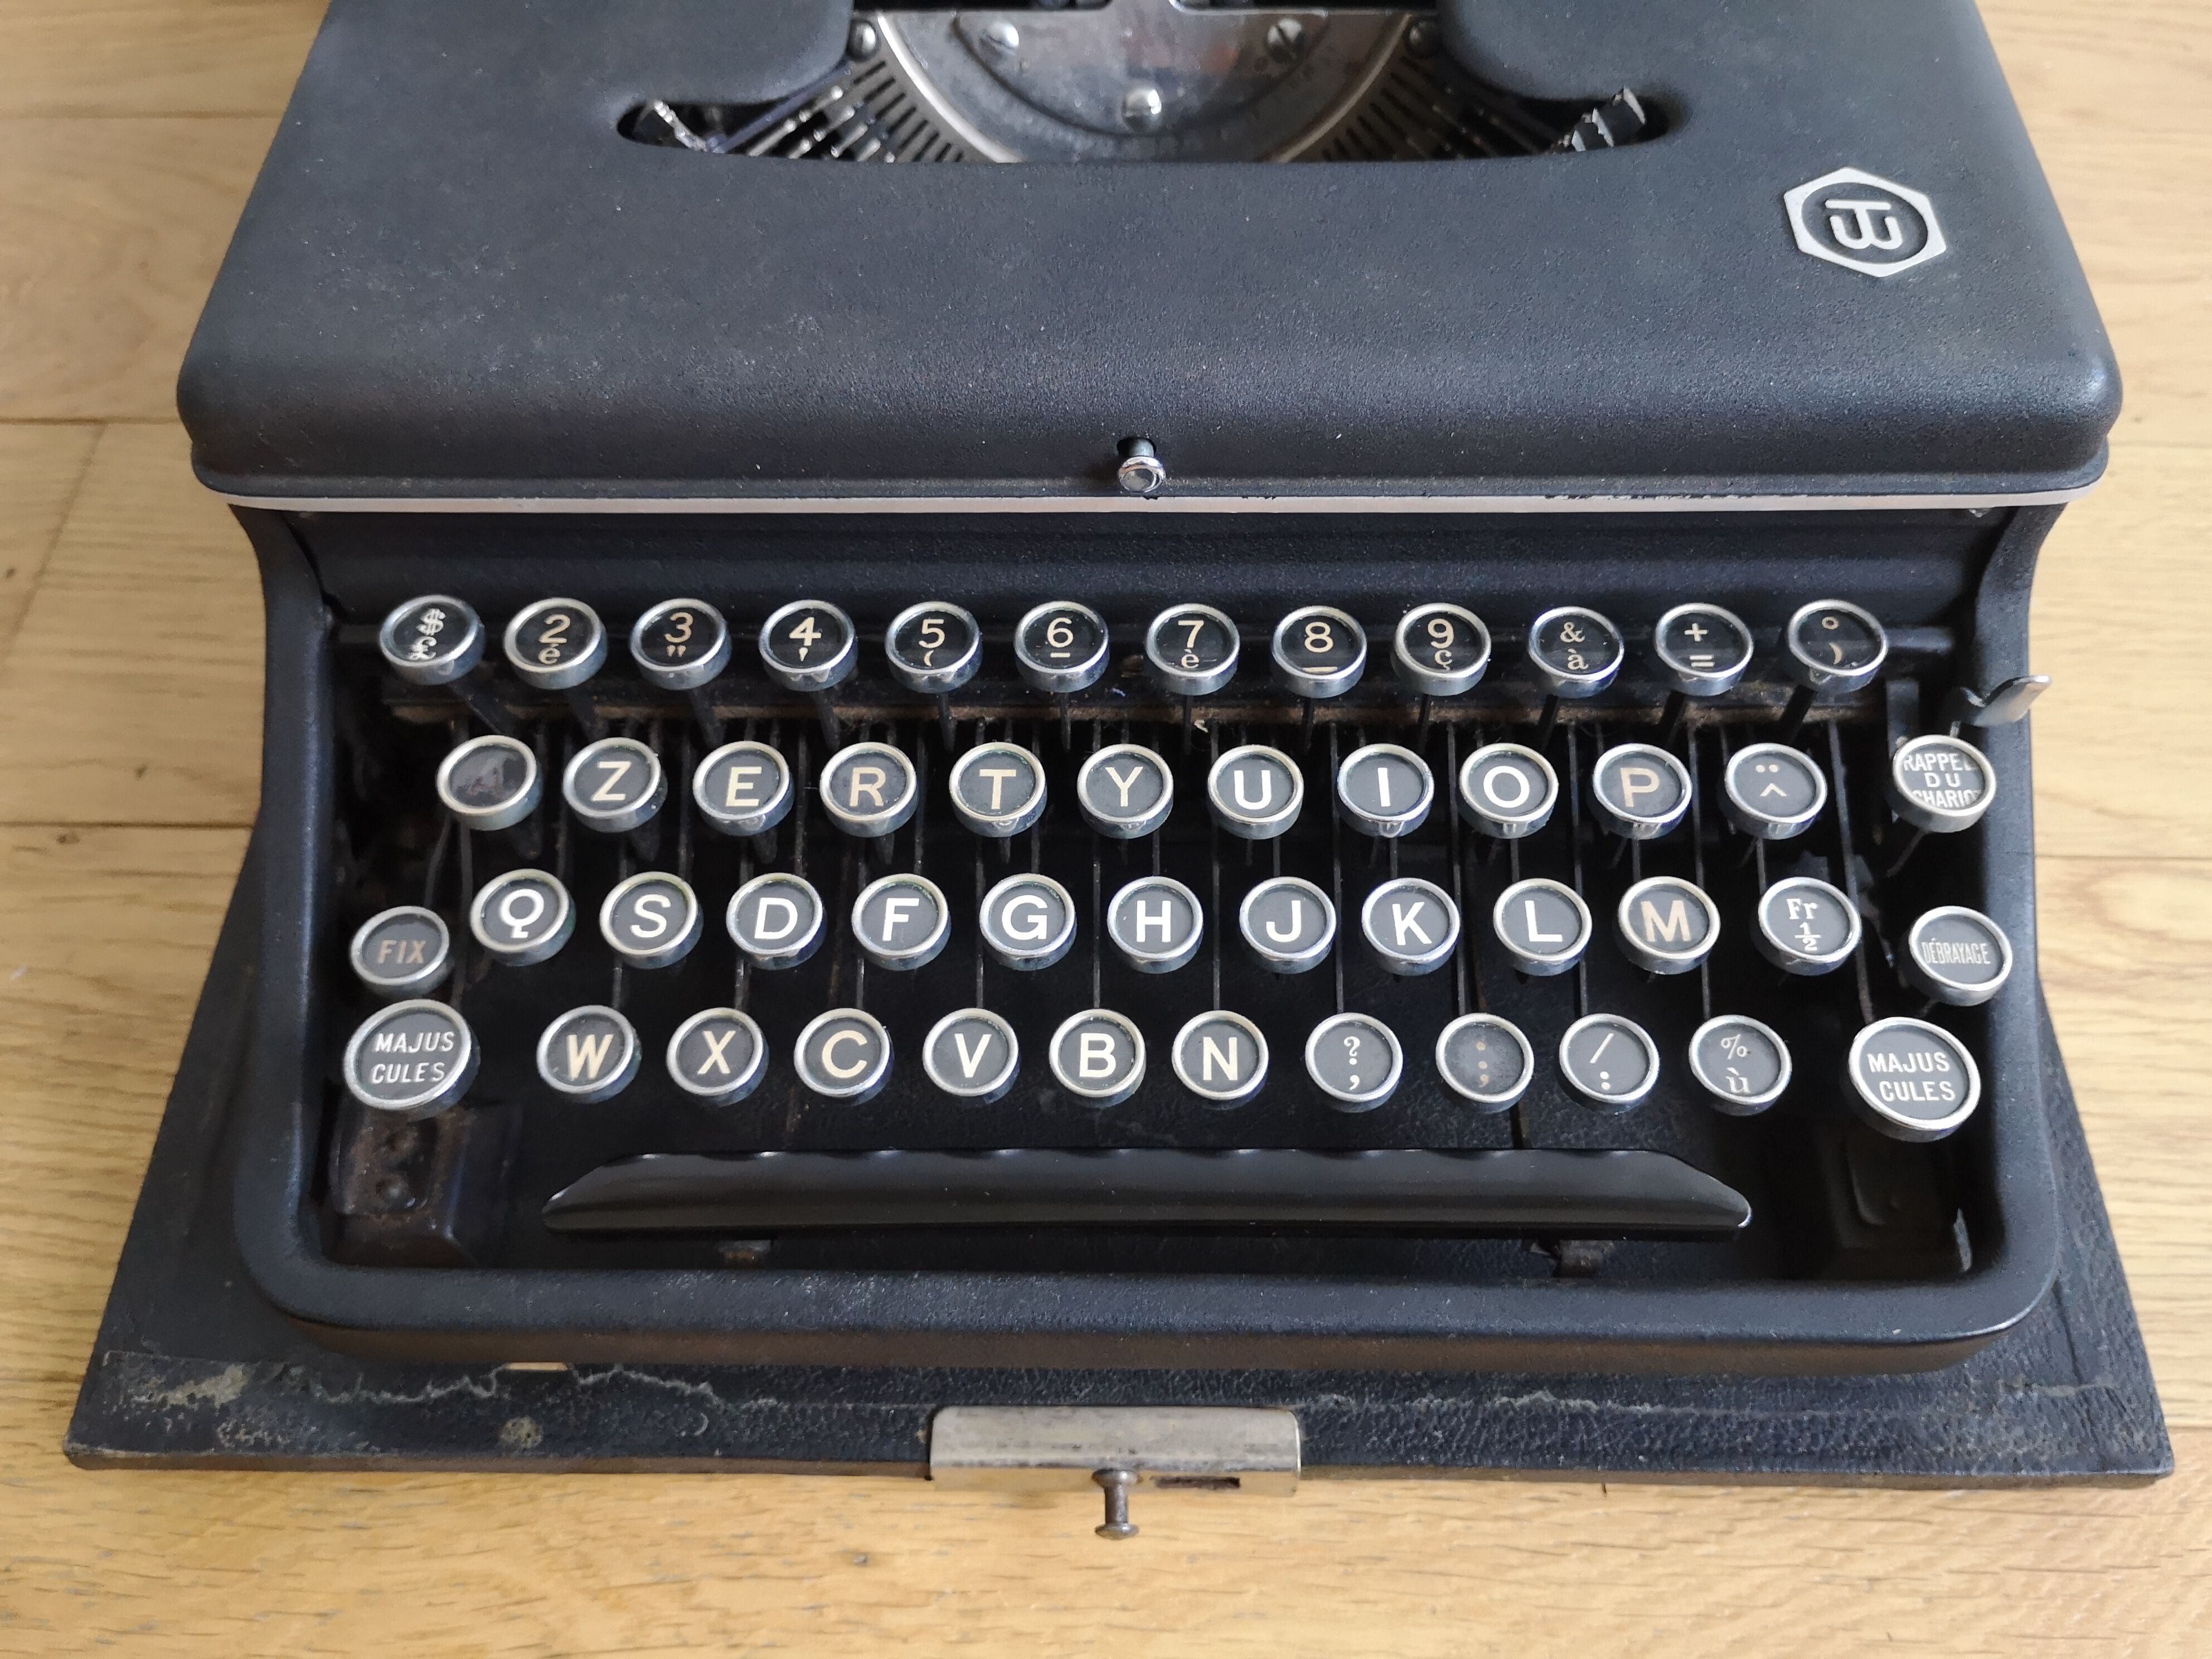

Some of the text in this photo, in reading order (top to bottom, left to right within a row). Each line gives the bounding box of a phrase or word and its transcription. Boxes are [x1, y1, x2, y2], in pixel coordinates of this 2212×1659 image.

[416, 608, 446, 636] $
[539, 614, 571, 646] 2
[664, 612, 693, 643] 3
[789, 617, 822, 647] 4
[918, 618, 945, 649] 5
[1047, 617, 1074, 648] 6
[1178, 620, 1204, 648] 7
[1304, 622, 1333, 653] 8
[1427, 618, 1454, 649] 9
[1560, 622, 1585, 643] &
[1684, 623, 1708, 642] +
[407, 636, 437, 661] £
[536, 643, 562, 665] é
[923, 649, 934, 667] (
[1181, 648, 1200, 670] è
[1433, 648, 1454, 671] ç
[1567, 648, 1589, 670] à
[1689, 654, 1715, 668] =
[591, 760, 632, 802] Z
[725, 766, 762, 807] E
[849, 767, 886, 807] R
[979, 769, 1017, 810] T
[1104, 766, 1144, 807] Y
[1234, 770, 1272, 810] U
[1377, 767, 1391, 807] I
[1483, 765, 1530, 808] O
[1619, 767, 1661, 808] P
[1924, 772, 1961, 793] DU
[501, 888, 545, 938] Q
[630, 894, 671, 938] S
[754, 897, 798, 940] D
[882, 898, 920, 942] F
[1001, 894, 1048, 940] G
[1136, 900, 1171, 943] H
[1265, 900, 1302, 943] J
[1392, 901, 1433, 946] K
[1524, 900, 1563, 943] L
[1640, 899, 1691, 943] M
[1786, 898, 1818, 920] Fr
[376, 939, 428, 964] FIX
[1921, 937, 1991, 965] DÉBRAYAGE
[375, 1031, 456, 1054] MAJUS
[566, 1034, 614, 1080] W
[697, 1030, 736, 1075] X
[821, 1030, 868, 1079] C
[954, 1033, 992, 1078] V
[1079, 1032, 1117, 1078] B
[1343, 1036, 1360, 1065] ?
[1589, 1033, 1614, 1064] /
[1720, 1033, 1748, 1060] %
[371, 1061, 447, 1085] CULES
[1202, 1036, 1238, 1081] N
[1867, 1051, 1950, 1073] MAJUS
[1599, 1071, 1611, 1090] :
[1725, 1066, 1752, 1094] ù
[1878, 1080, 1957, 1102] CULES
